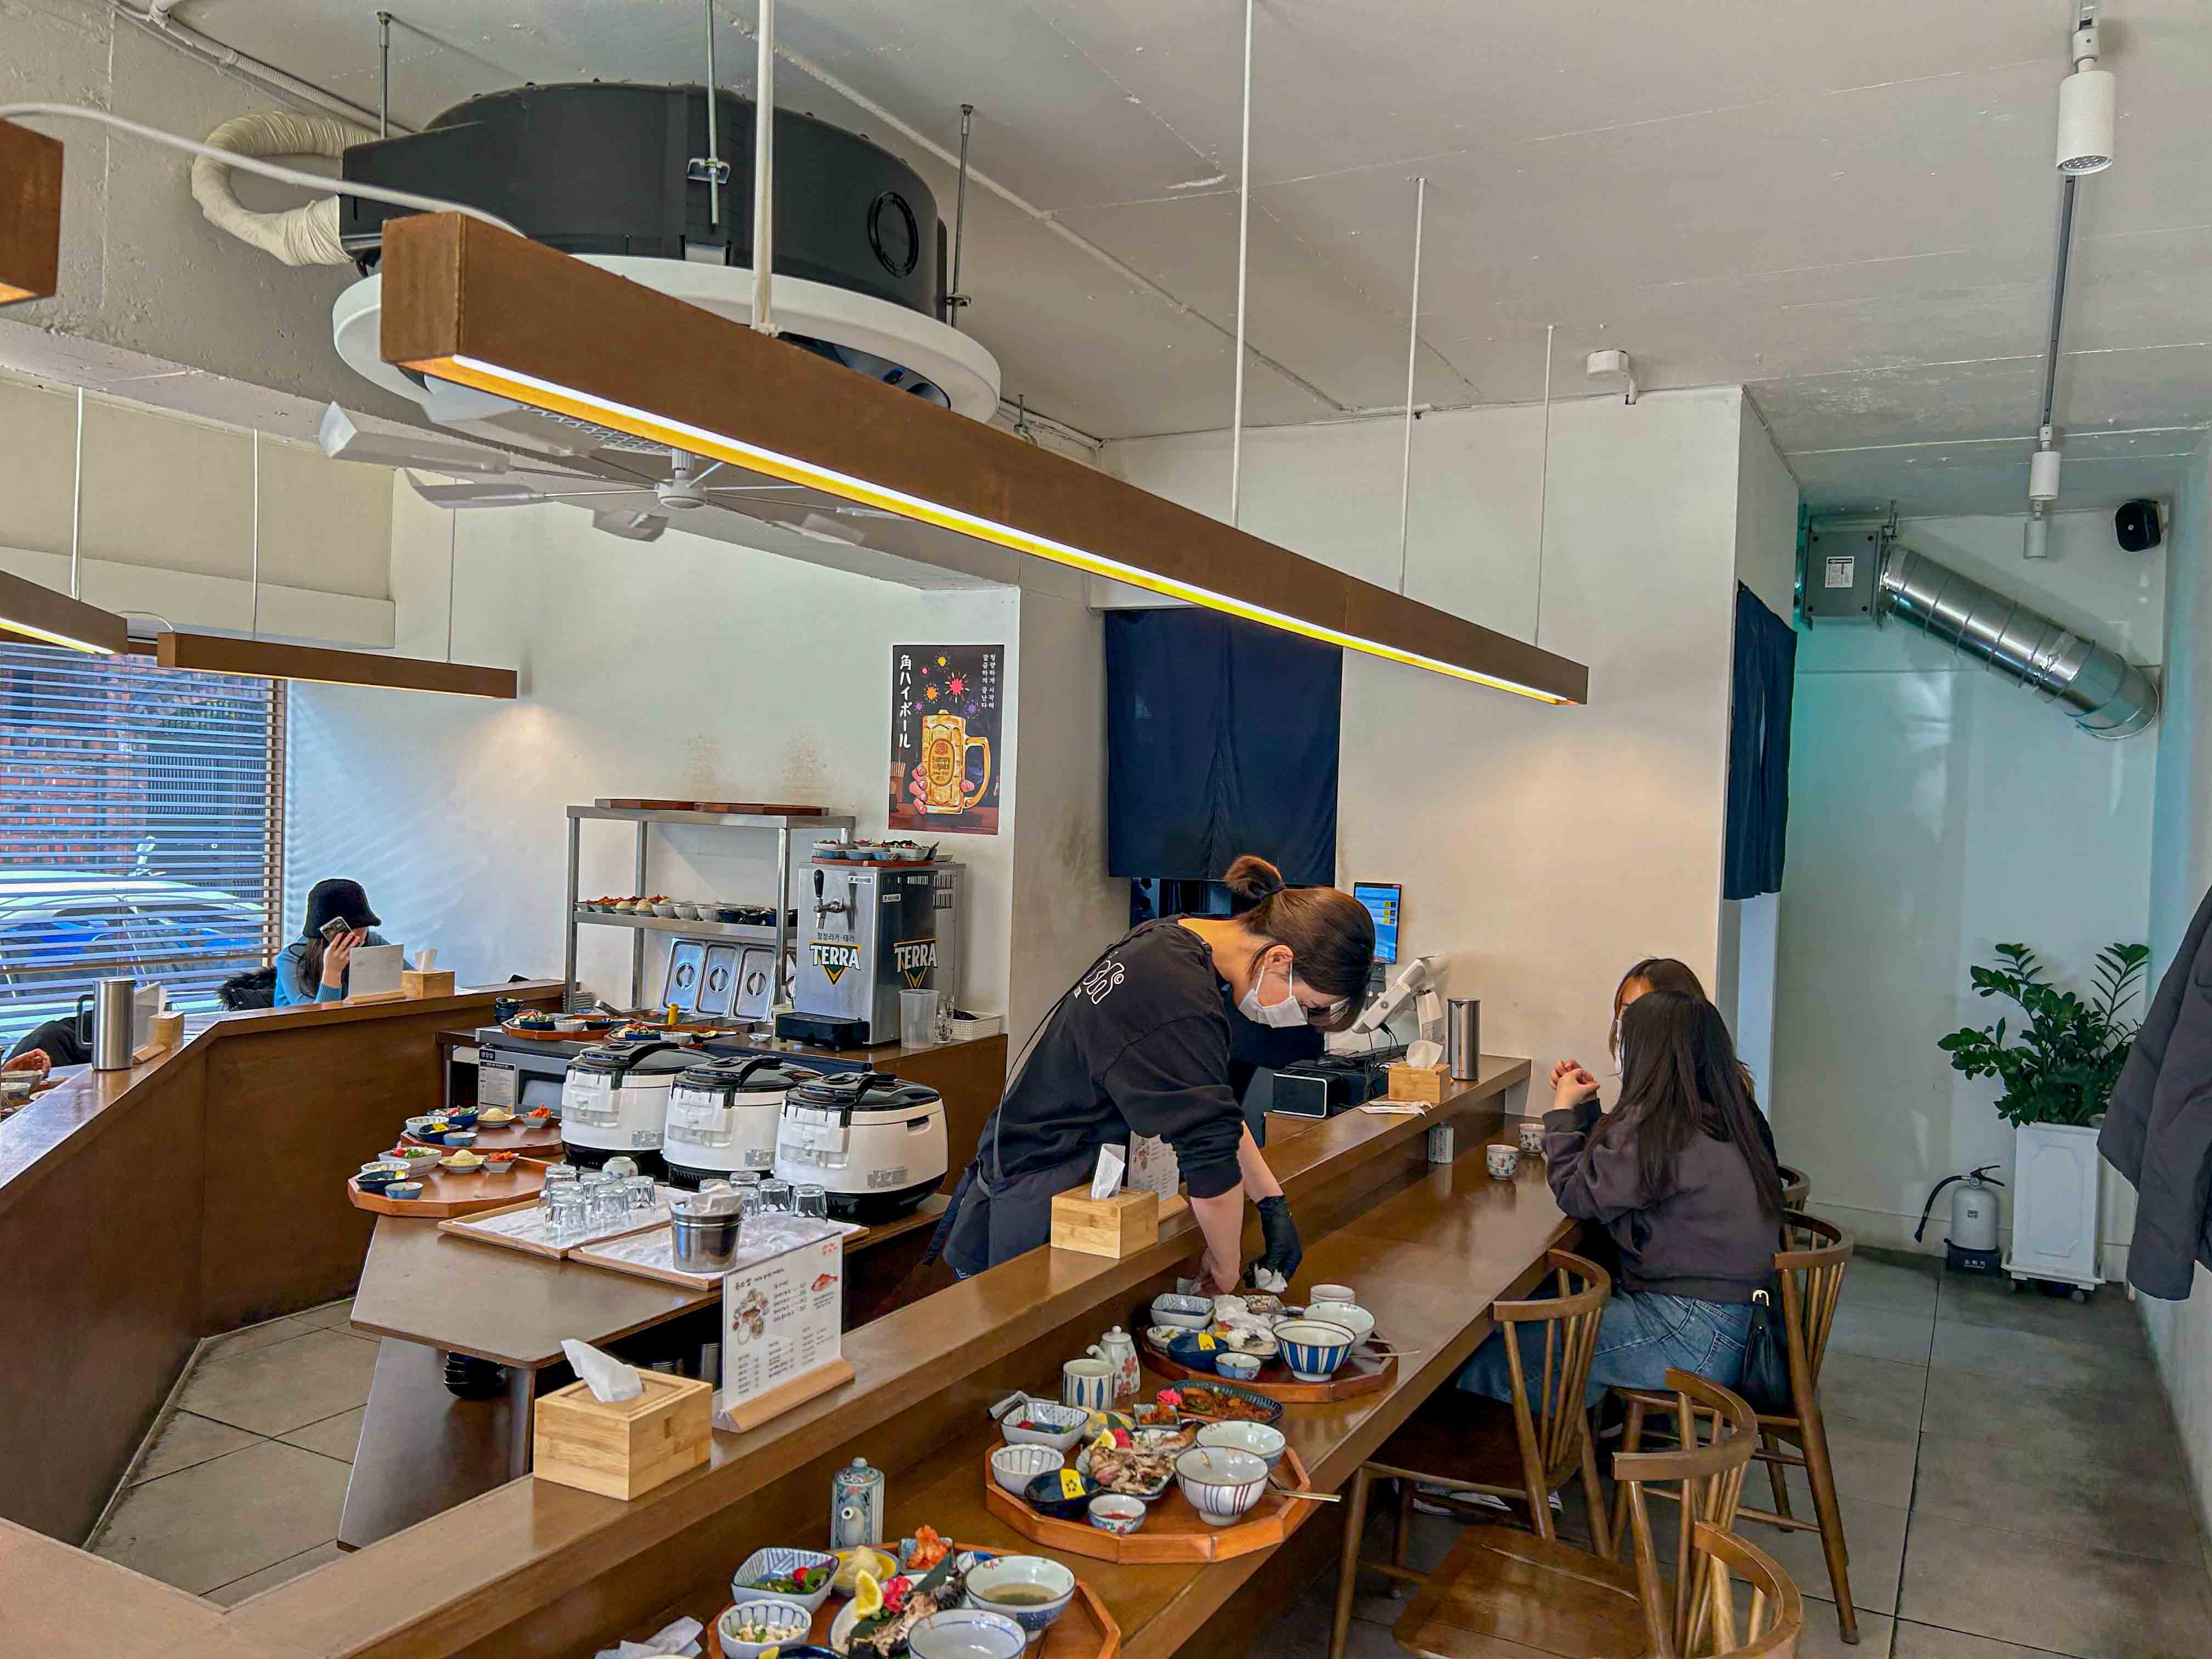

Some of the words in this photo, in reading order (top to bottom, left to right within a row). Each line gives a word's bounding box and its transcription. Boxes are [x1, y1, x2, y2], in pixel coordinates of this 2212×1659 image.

[899, 654, 913, 749] 角ハイボール
[810, 945, 861, 970] TERRA
[894, 943, 939, 973] TERRA
